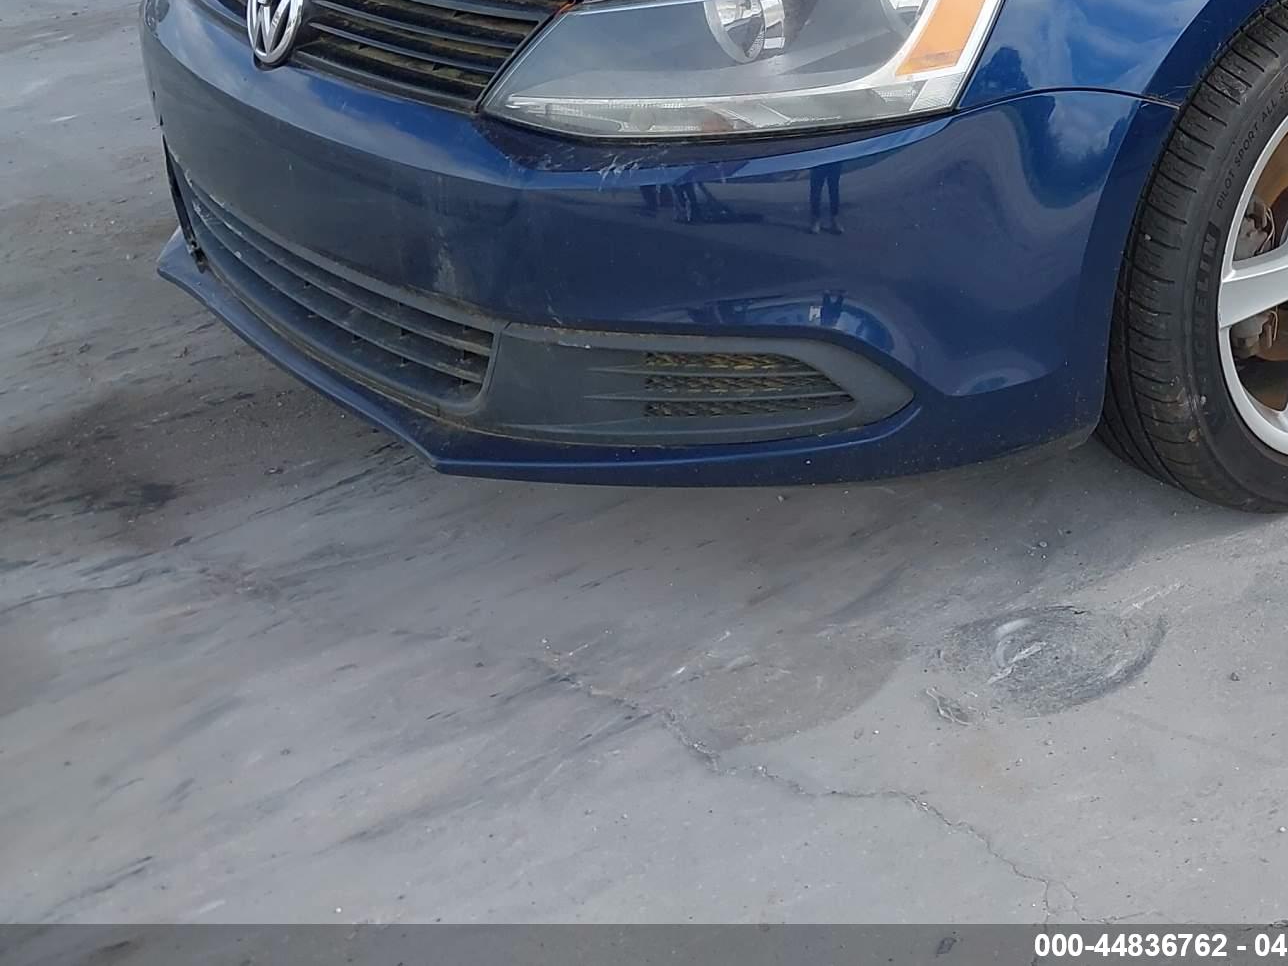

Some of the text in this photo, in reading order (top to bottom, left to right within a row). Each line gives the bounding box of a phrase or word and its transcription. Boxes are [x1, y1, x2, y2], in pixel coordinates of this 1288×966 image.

[1216, 170, 1236, 209] PILOT
[1234, 121, 1259, 167] SPORT
[1262, 99, 1277, 122] ALL
